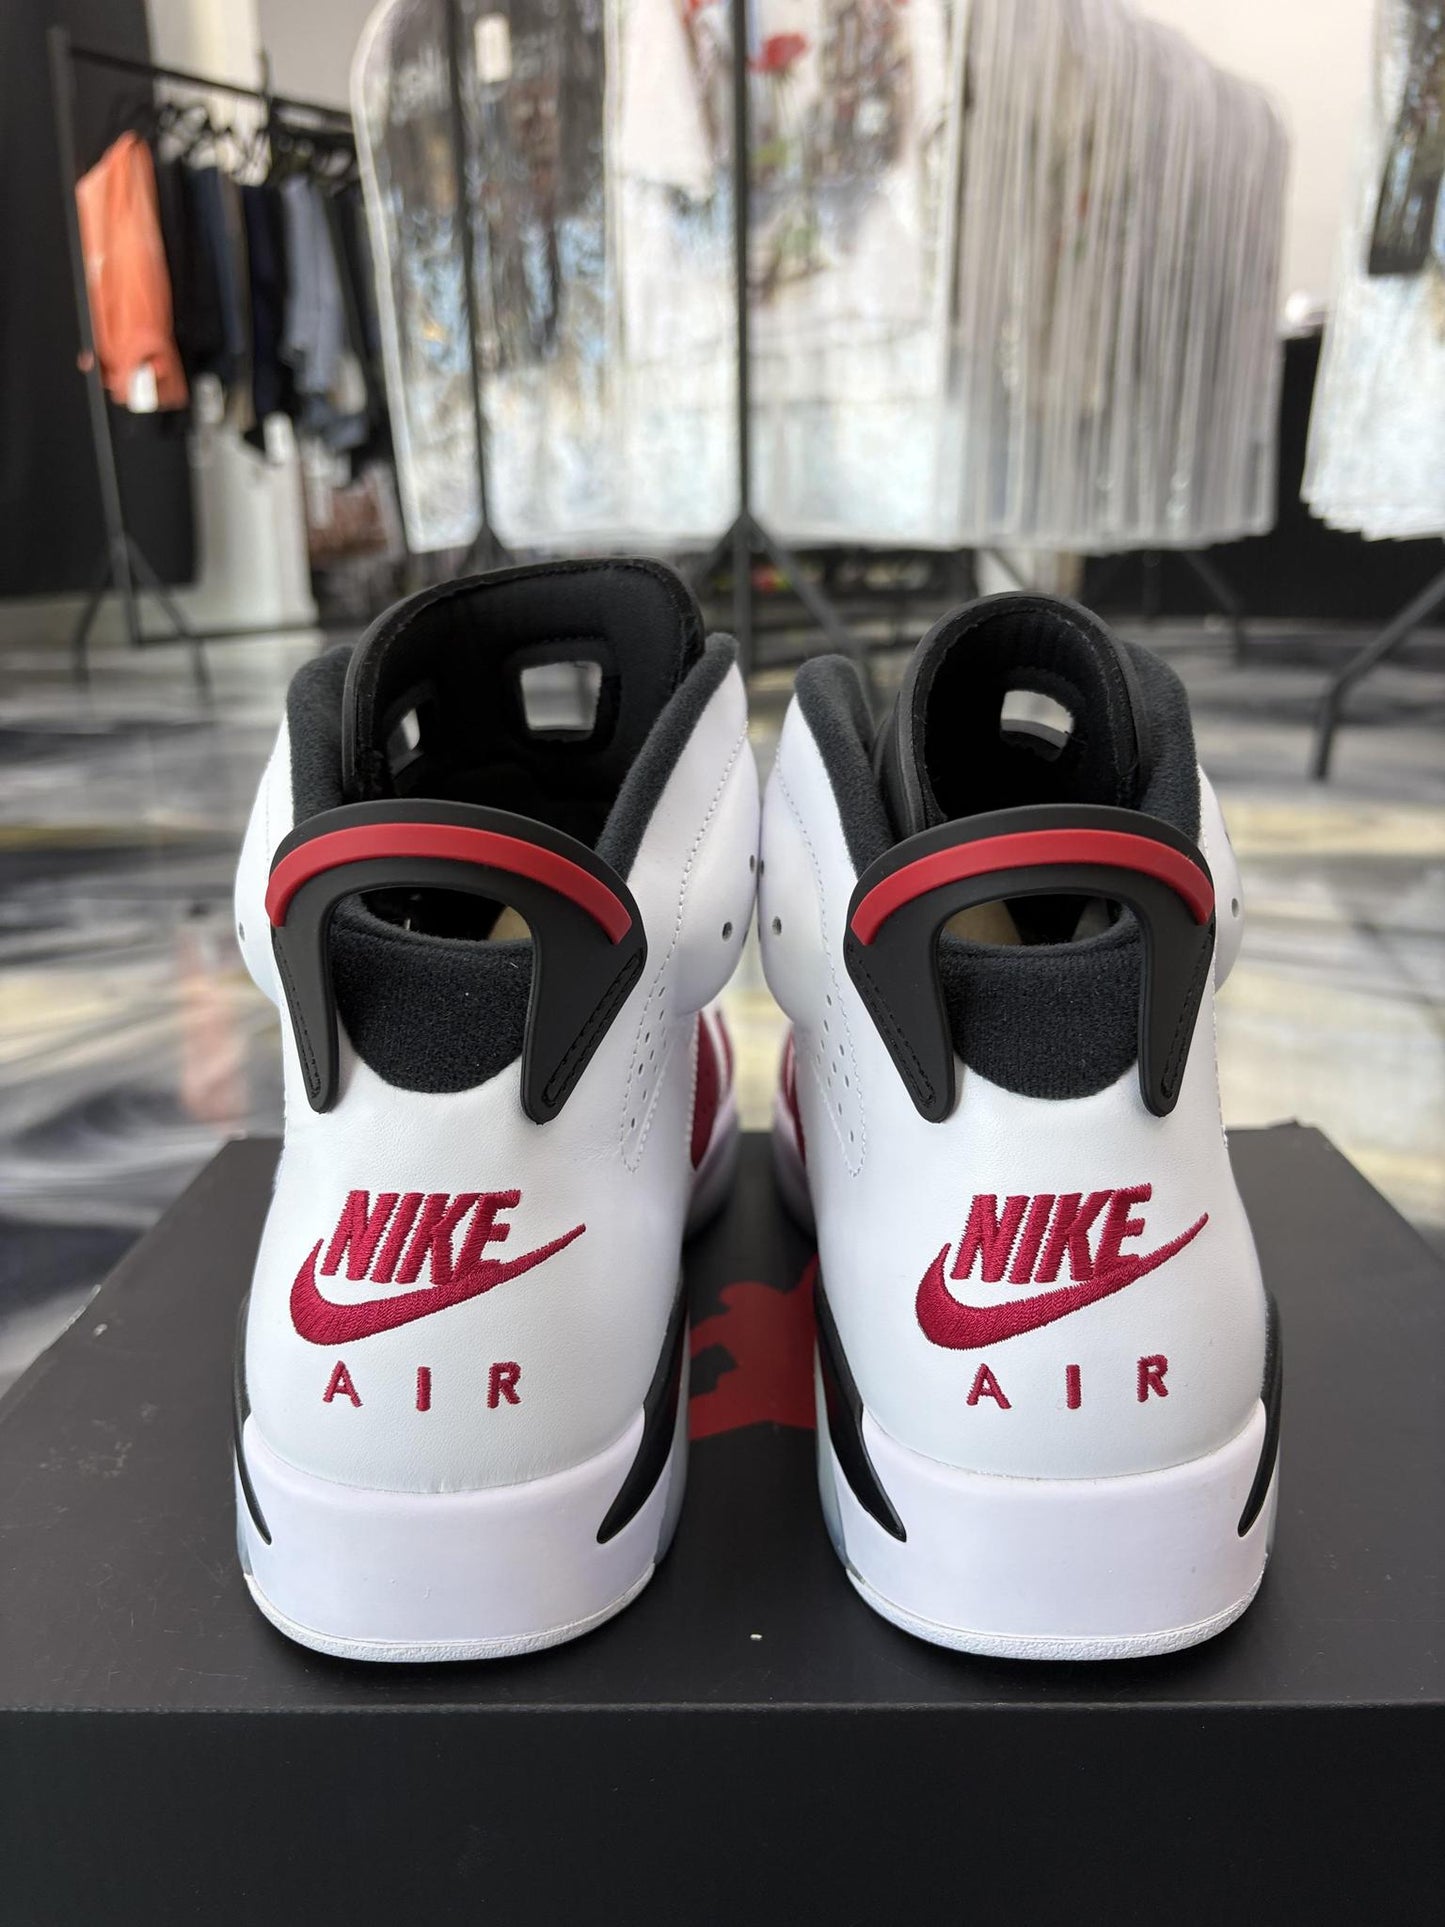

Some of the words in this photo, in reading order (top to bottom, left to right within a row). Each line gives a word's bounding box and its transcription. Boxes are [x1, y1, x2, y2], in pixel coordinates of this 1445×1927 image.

[320, 1189, 522, 1285] NIKE
[950, 1182, 1153, 1285] NIKE
[322, 1360, 522, 1412] AIR
[966, 1354, 1169, 1410] AIR
